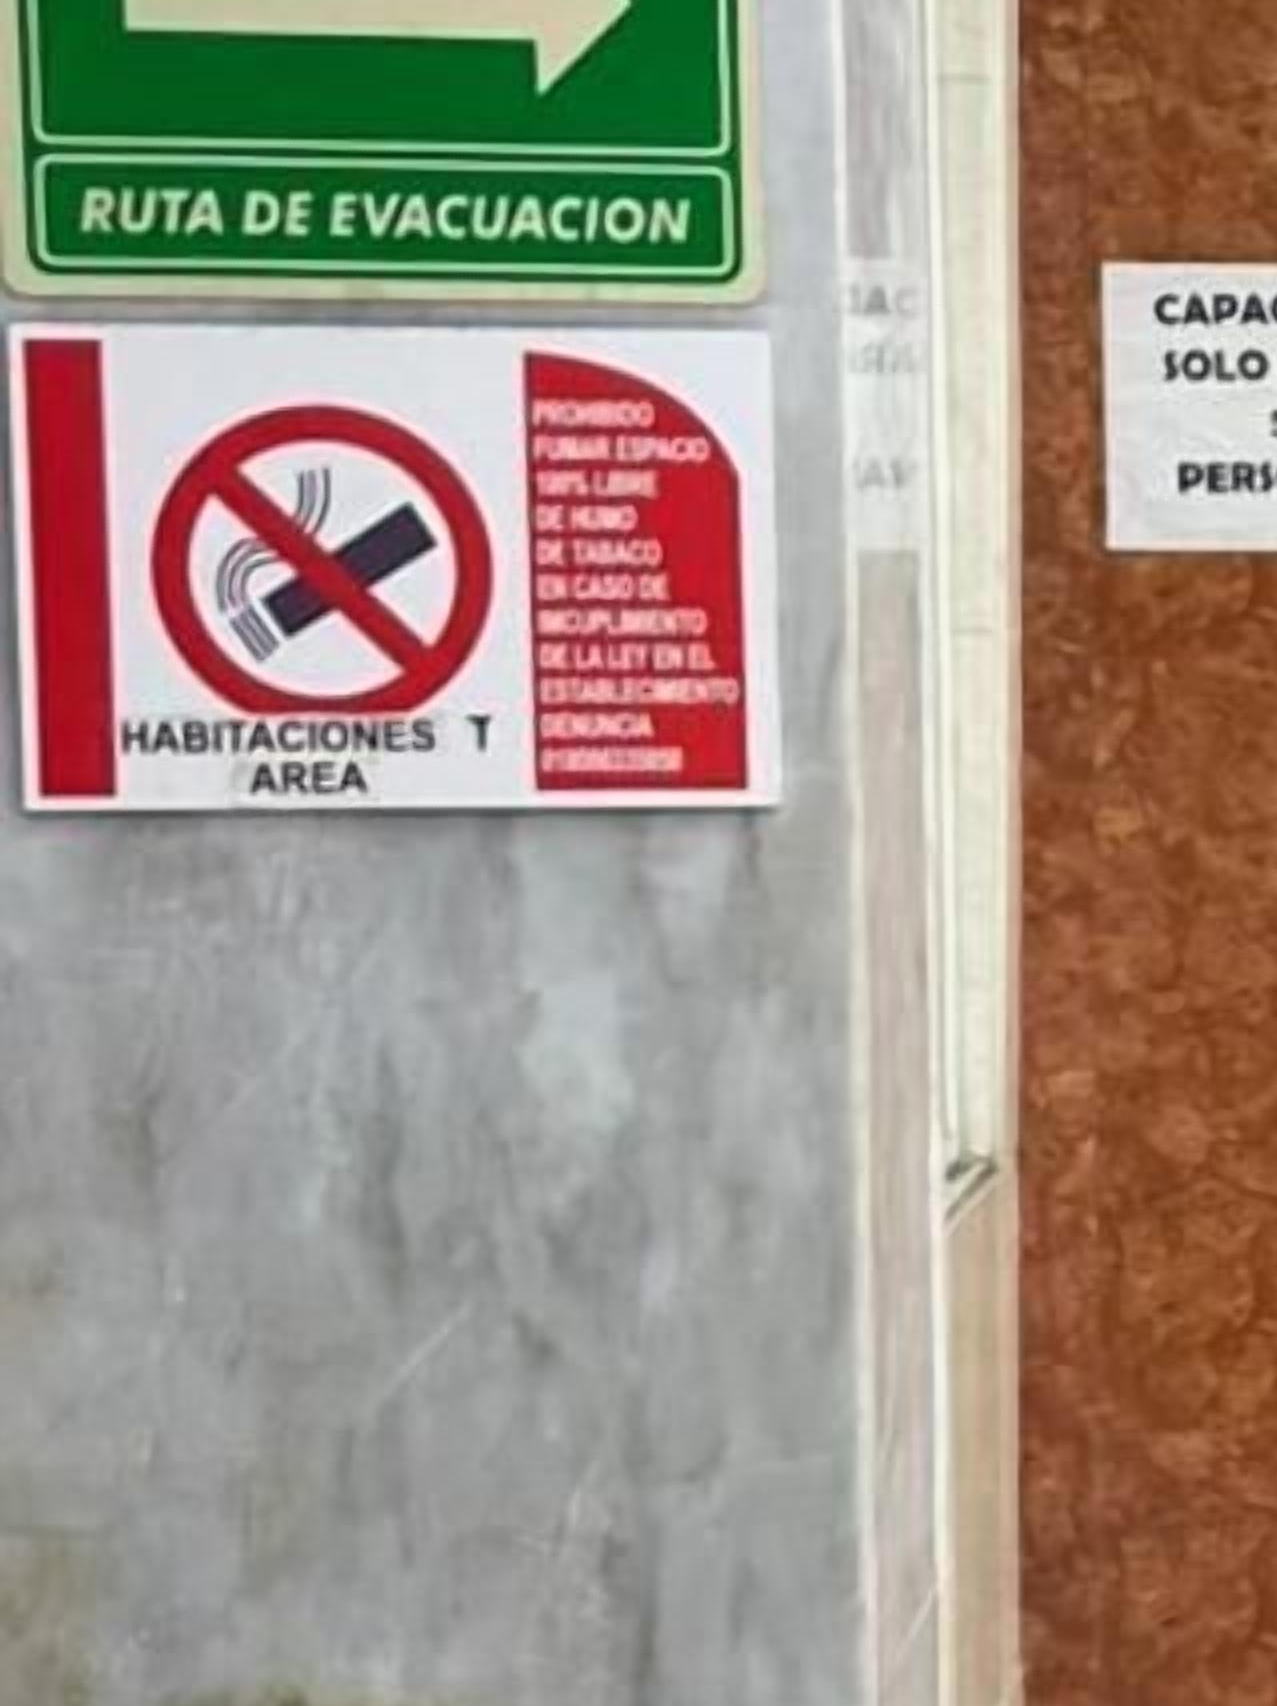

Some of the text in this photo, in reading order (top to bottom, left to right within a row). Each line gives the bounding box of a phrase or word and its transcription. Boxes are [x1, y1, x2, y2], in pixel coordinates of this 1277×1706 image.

[80, 188, 690, 244] RUTA DE EVACUACION
[1163, 348, 1270, 381] SOLO
[536, 504, 564, 532] DE
[536, 539, 564, 566] DE
[540, 642, 568, 670] DE
[575, 642, 603, 670] LA
[688, 642, 717, 671] EL
[121, 720, 436, 754] HABITACIONES
[250, 760, 368, 795] AREA
